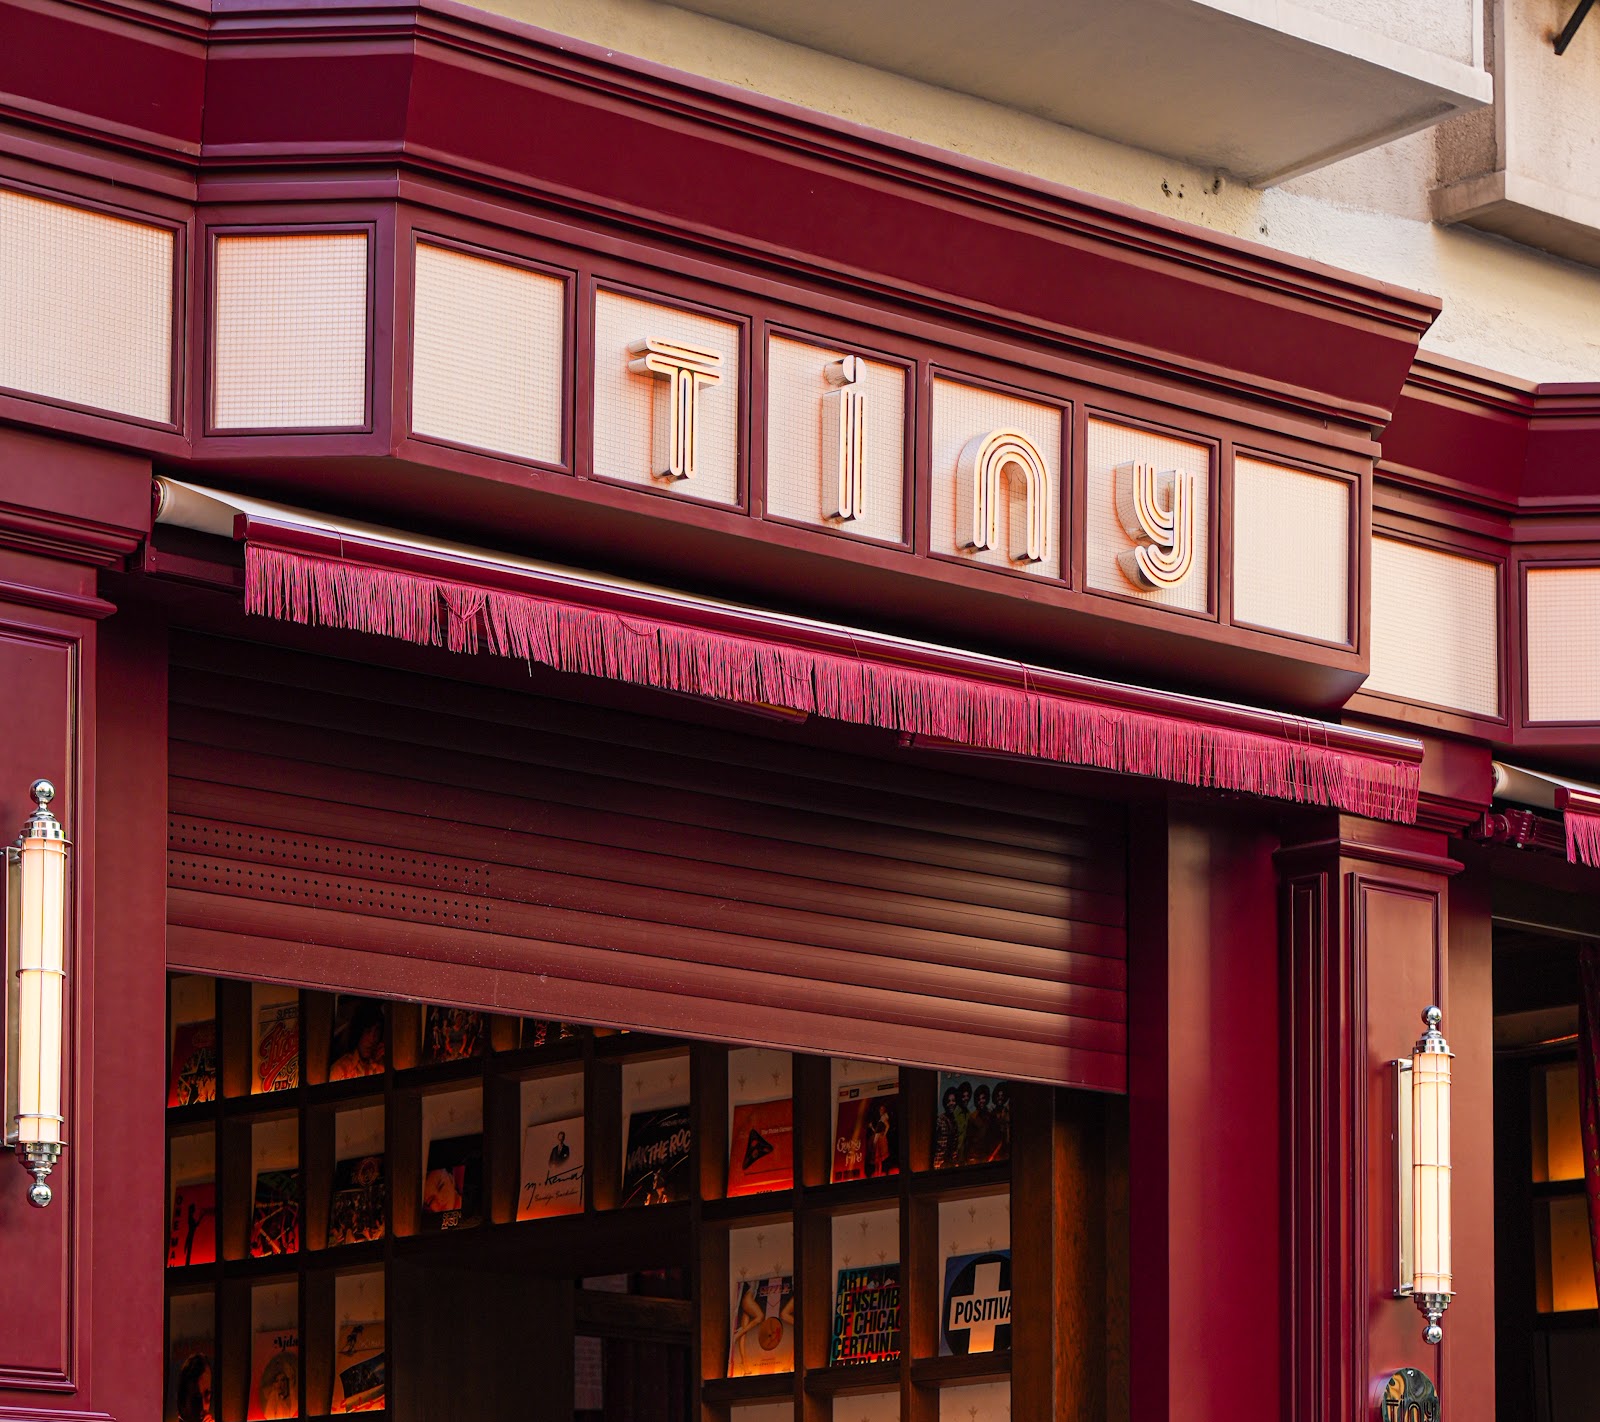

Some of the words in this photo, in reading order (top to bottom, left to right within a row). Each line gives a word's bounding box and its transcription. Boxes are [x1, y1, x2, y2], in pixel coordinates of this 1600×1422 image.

[630, 335, 1197, 590] Tiny
[648, 1140, 669, 1165] THE
[834, 1314, 849, 1337] OF
[832, 1331, 891, 1360] CERTAIN
